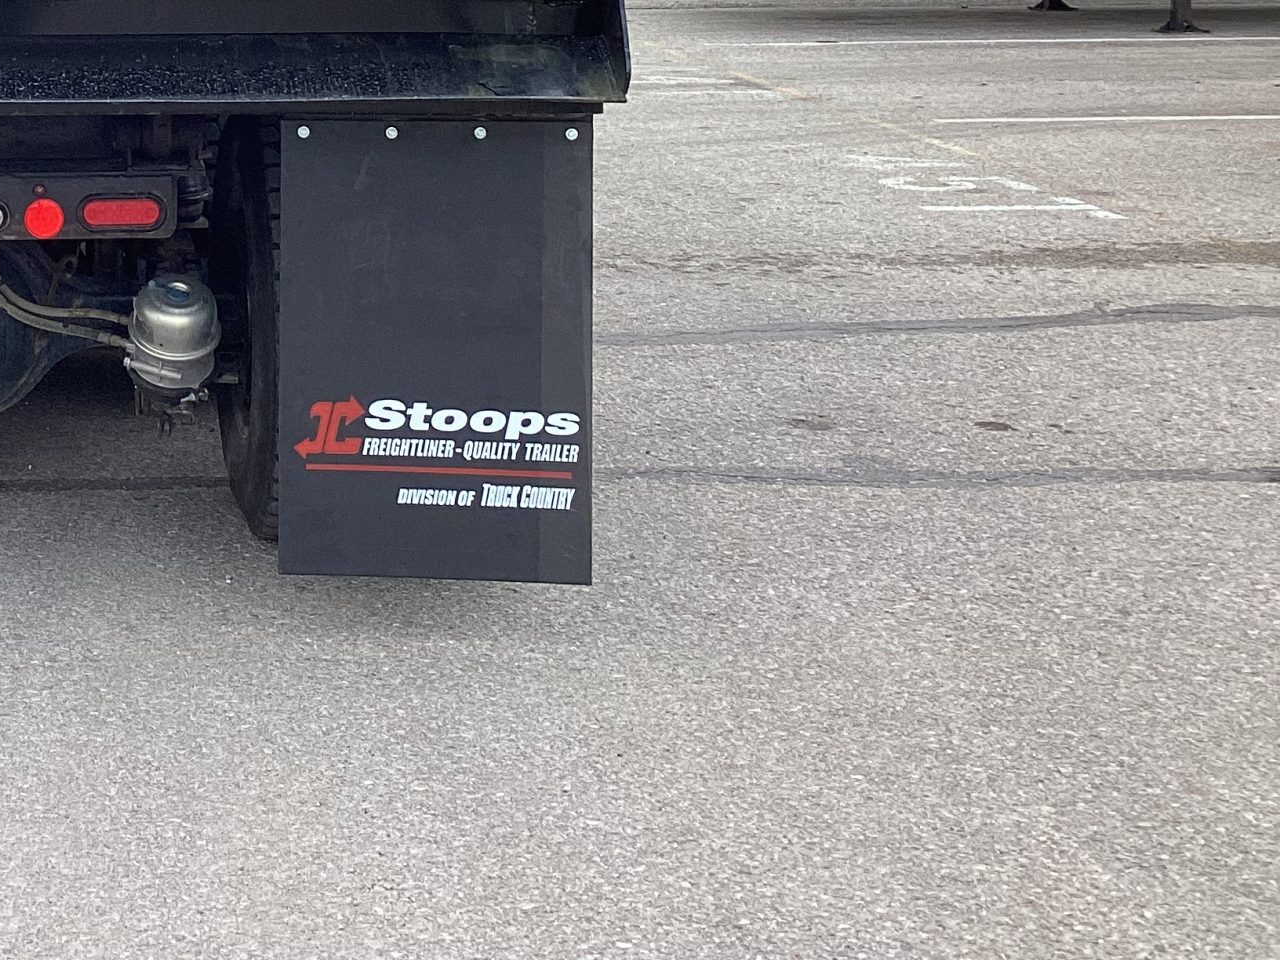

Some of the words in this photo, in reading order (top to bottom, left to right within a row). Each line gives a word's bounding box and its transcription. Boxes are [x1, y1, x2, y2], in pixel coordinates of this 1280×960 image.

[364, 399, 581, 440] Stoops
[524, 442, 580, 463] TRAILER
[397, 488, 456, 506] DIVISION
[456, 490, 476, 507] OF
[480, 483, 519, 508] TRUCK
[519, 484, 576, 511] COUNTRY
